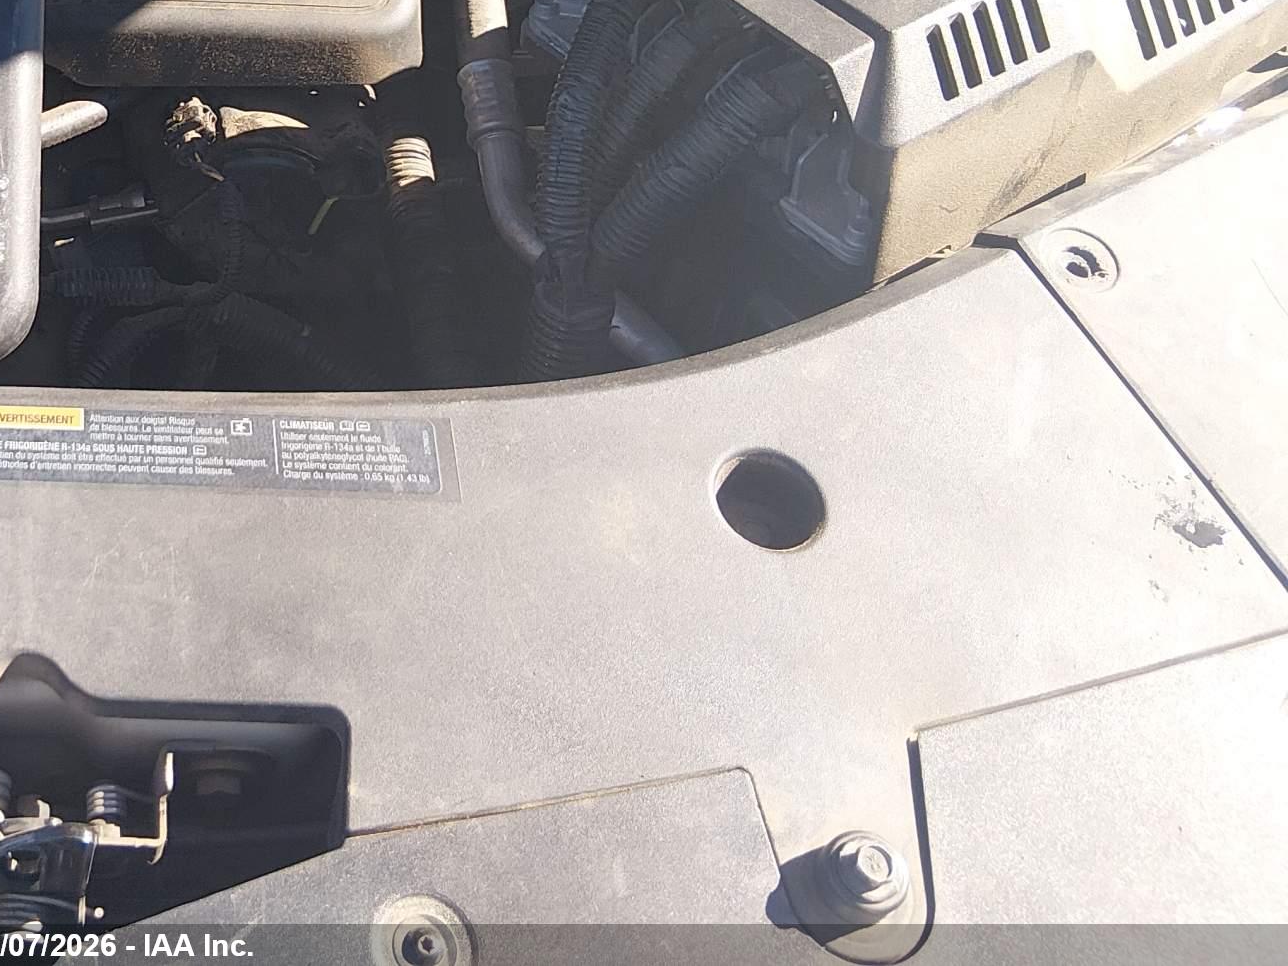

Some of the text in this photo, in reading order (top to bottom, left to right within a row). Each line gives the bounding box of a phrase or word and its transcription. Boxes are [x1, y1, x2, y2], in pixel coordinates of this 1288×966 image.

[90, 414, 124, 425] Attention
[125, 416, 140, 425] aux
[142, 424, 152, 433] Le
[279, 420, 335, 431] CLIMATISEUR
[280, 431, 307, 441] Utiliser
[308, 432, 349, 442] seulement
[61, 442, 91, 452] R-134a
[92, 442, 115, 452] SOUS
[117, 443, 145, 453] HAUTE
[146, 444, 188, 455] PRESSION
[325, 443, 354, 452] R-134a
[365, 444, 375, 452] de
[15, 450, 26, 459] du
[61, 451, 76, 460] doit
[128, 455, 141, 465] par
[155, 455, 194, 465] personnel
[73, 462, 117, 472] incorrectes
[118, 465, 150, 474] peuvent
[151, 465, 178, 474] causer
[179, 465, 193, 474] des
[283, 460, 293, 468] Le
[294, 461, 327, 471] système
[328, 462, 361, 471] contient
[362, 463, 373, 471] du
[283, 469, 311, 481] Charge
[312, 470, 323, 479] du
[325, 471, 358, 481] système
[384, 473, 395, 484] kg
